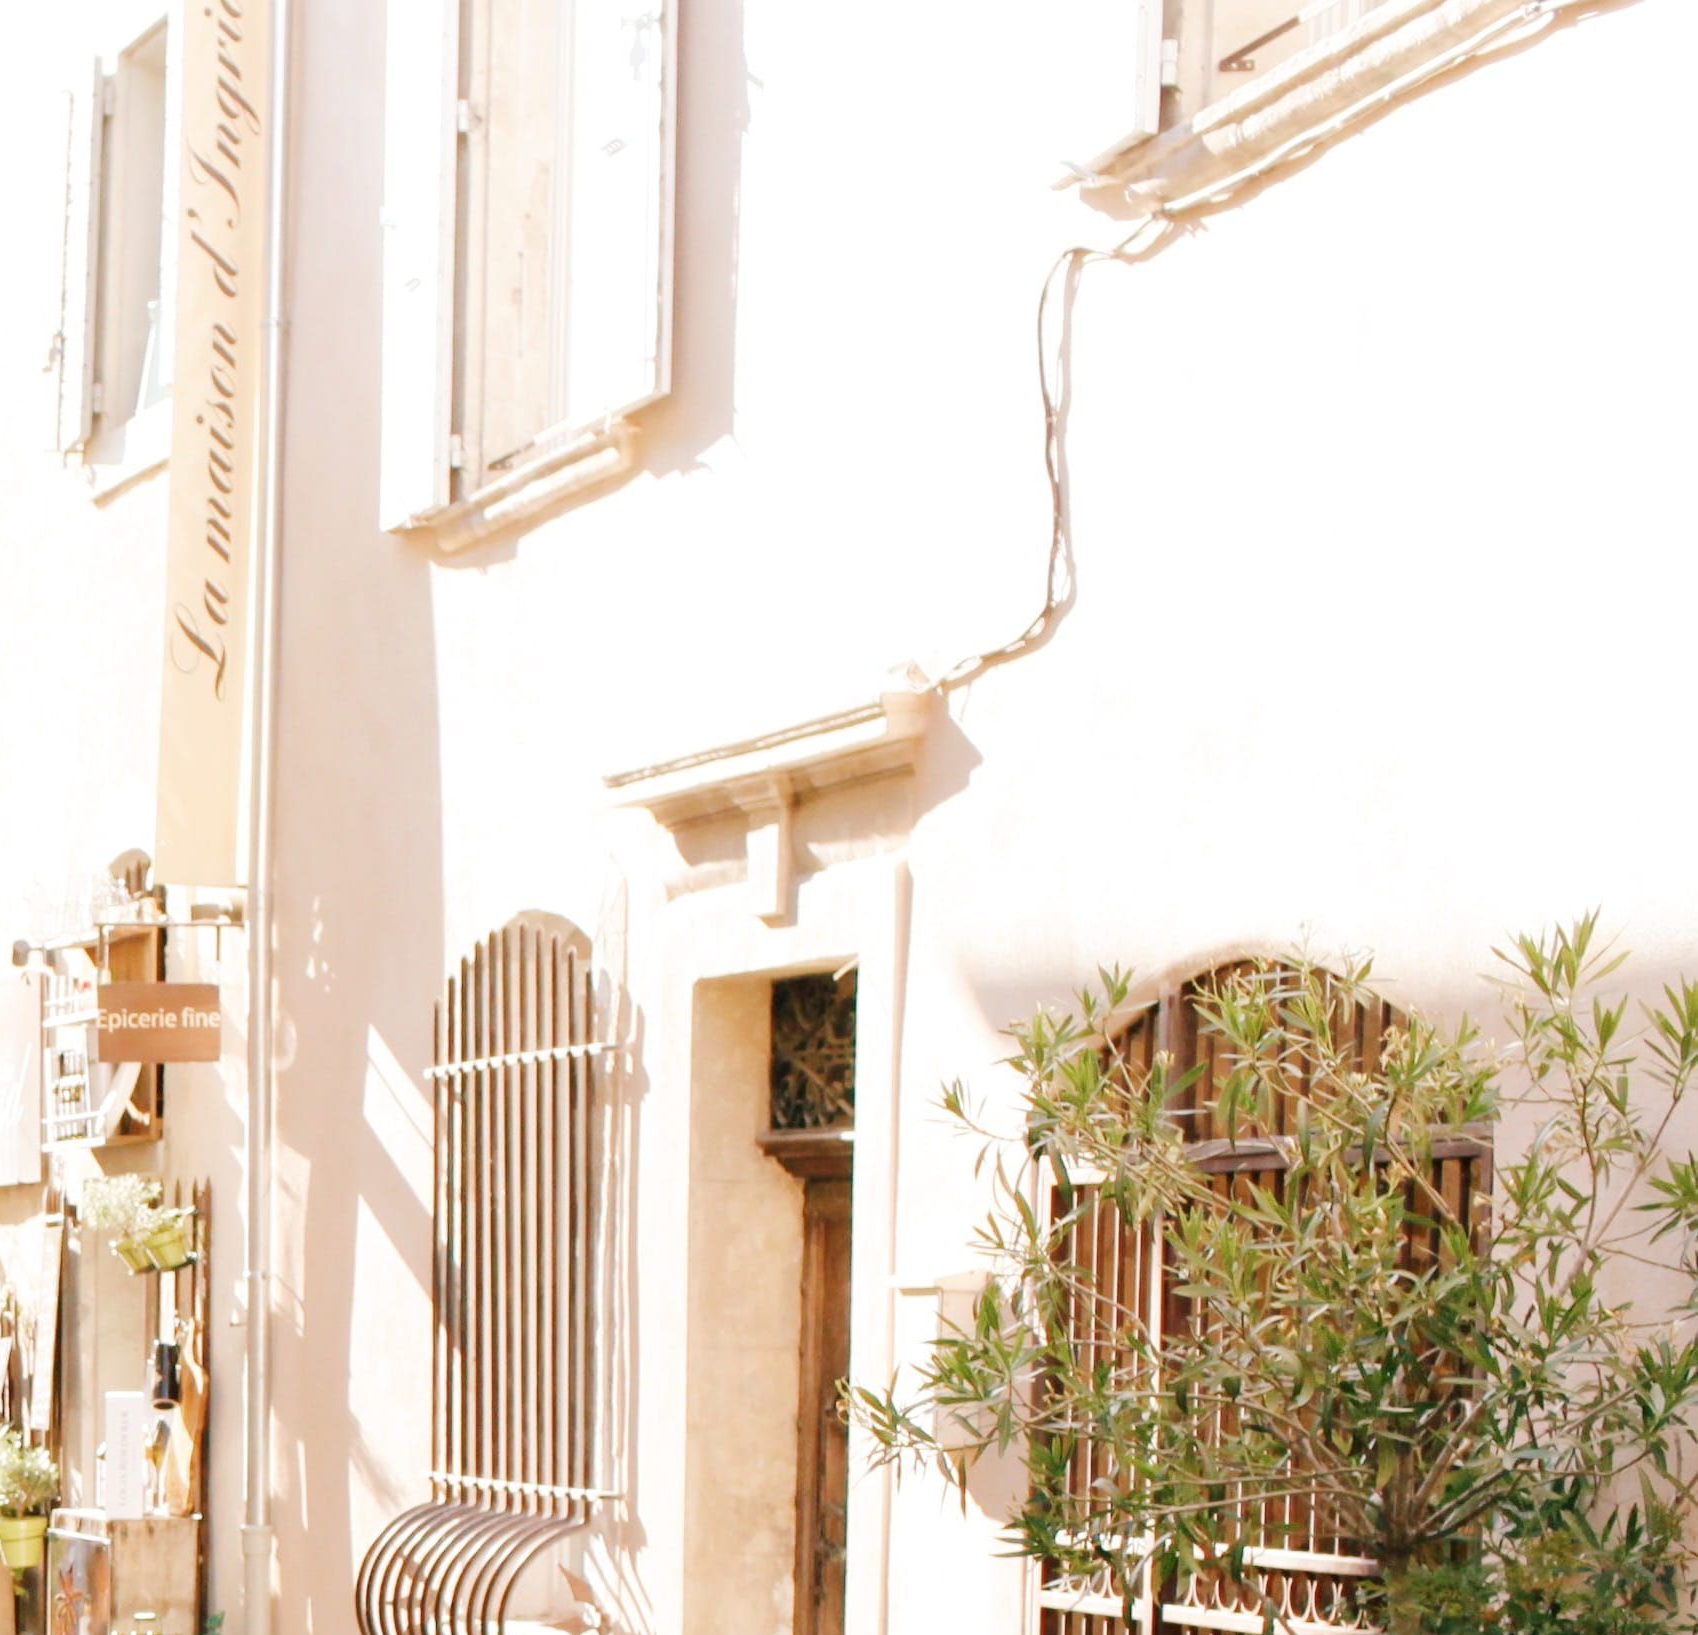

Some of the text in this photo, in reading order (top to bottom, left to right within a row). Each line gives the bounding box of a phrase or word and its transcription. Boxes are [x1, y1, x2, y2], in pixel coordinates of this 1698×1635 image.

[194, 321, 238, 564] maison
[170, 577, 230, 702] La
[96, 1006, 221, 1033] Epicerie fine
